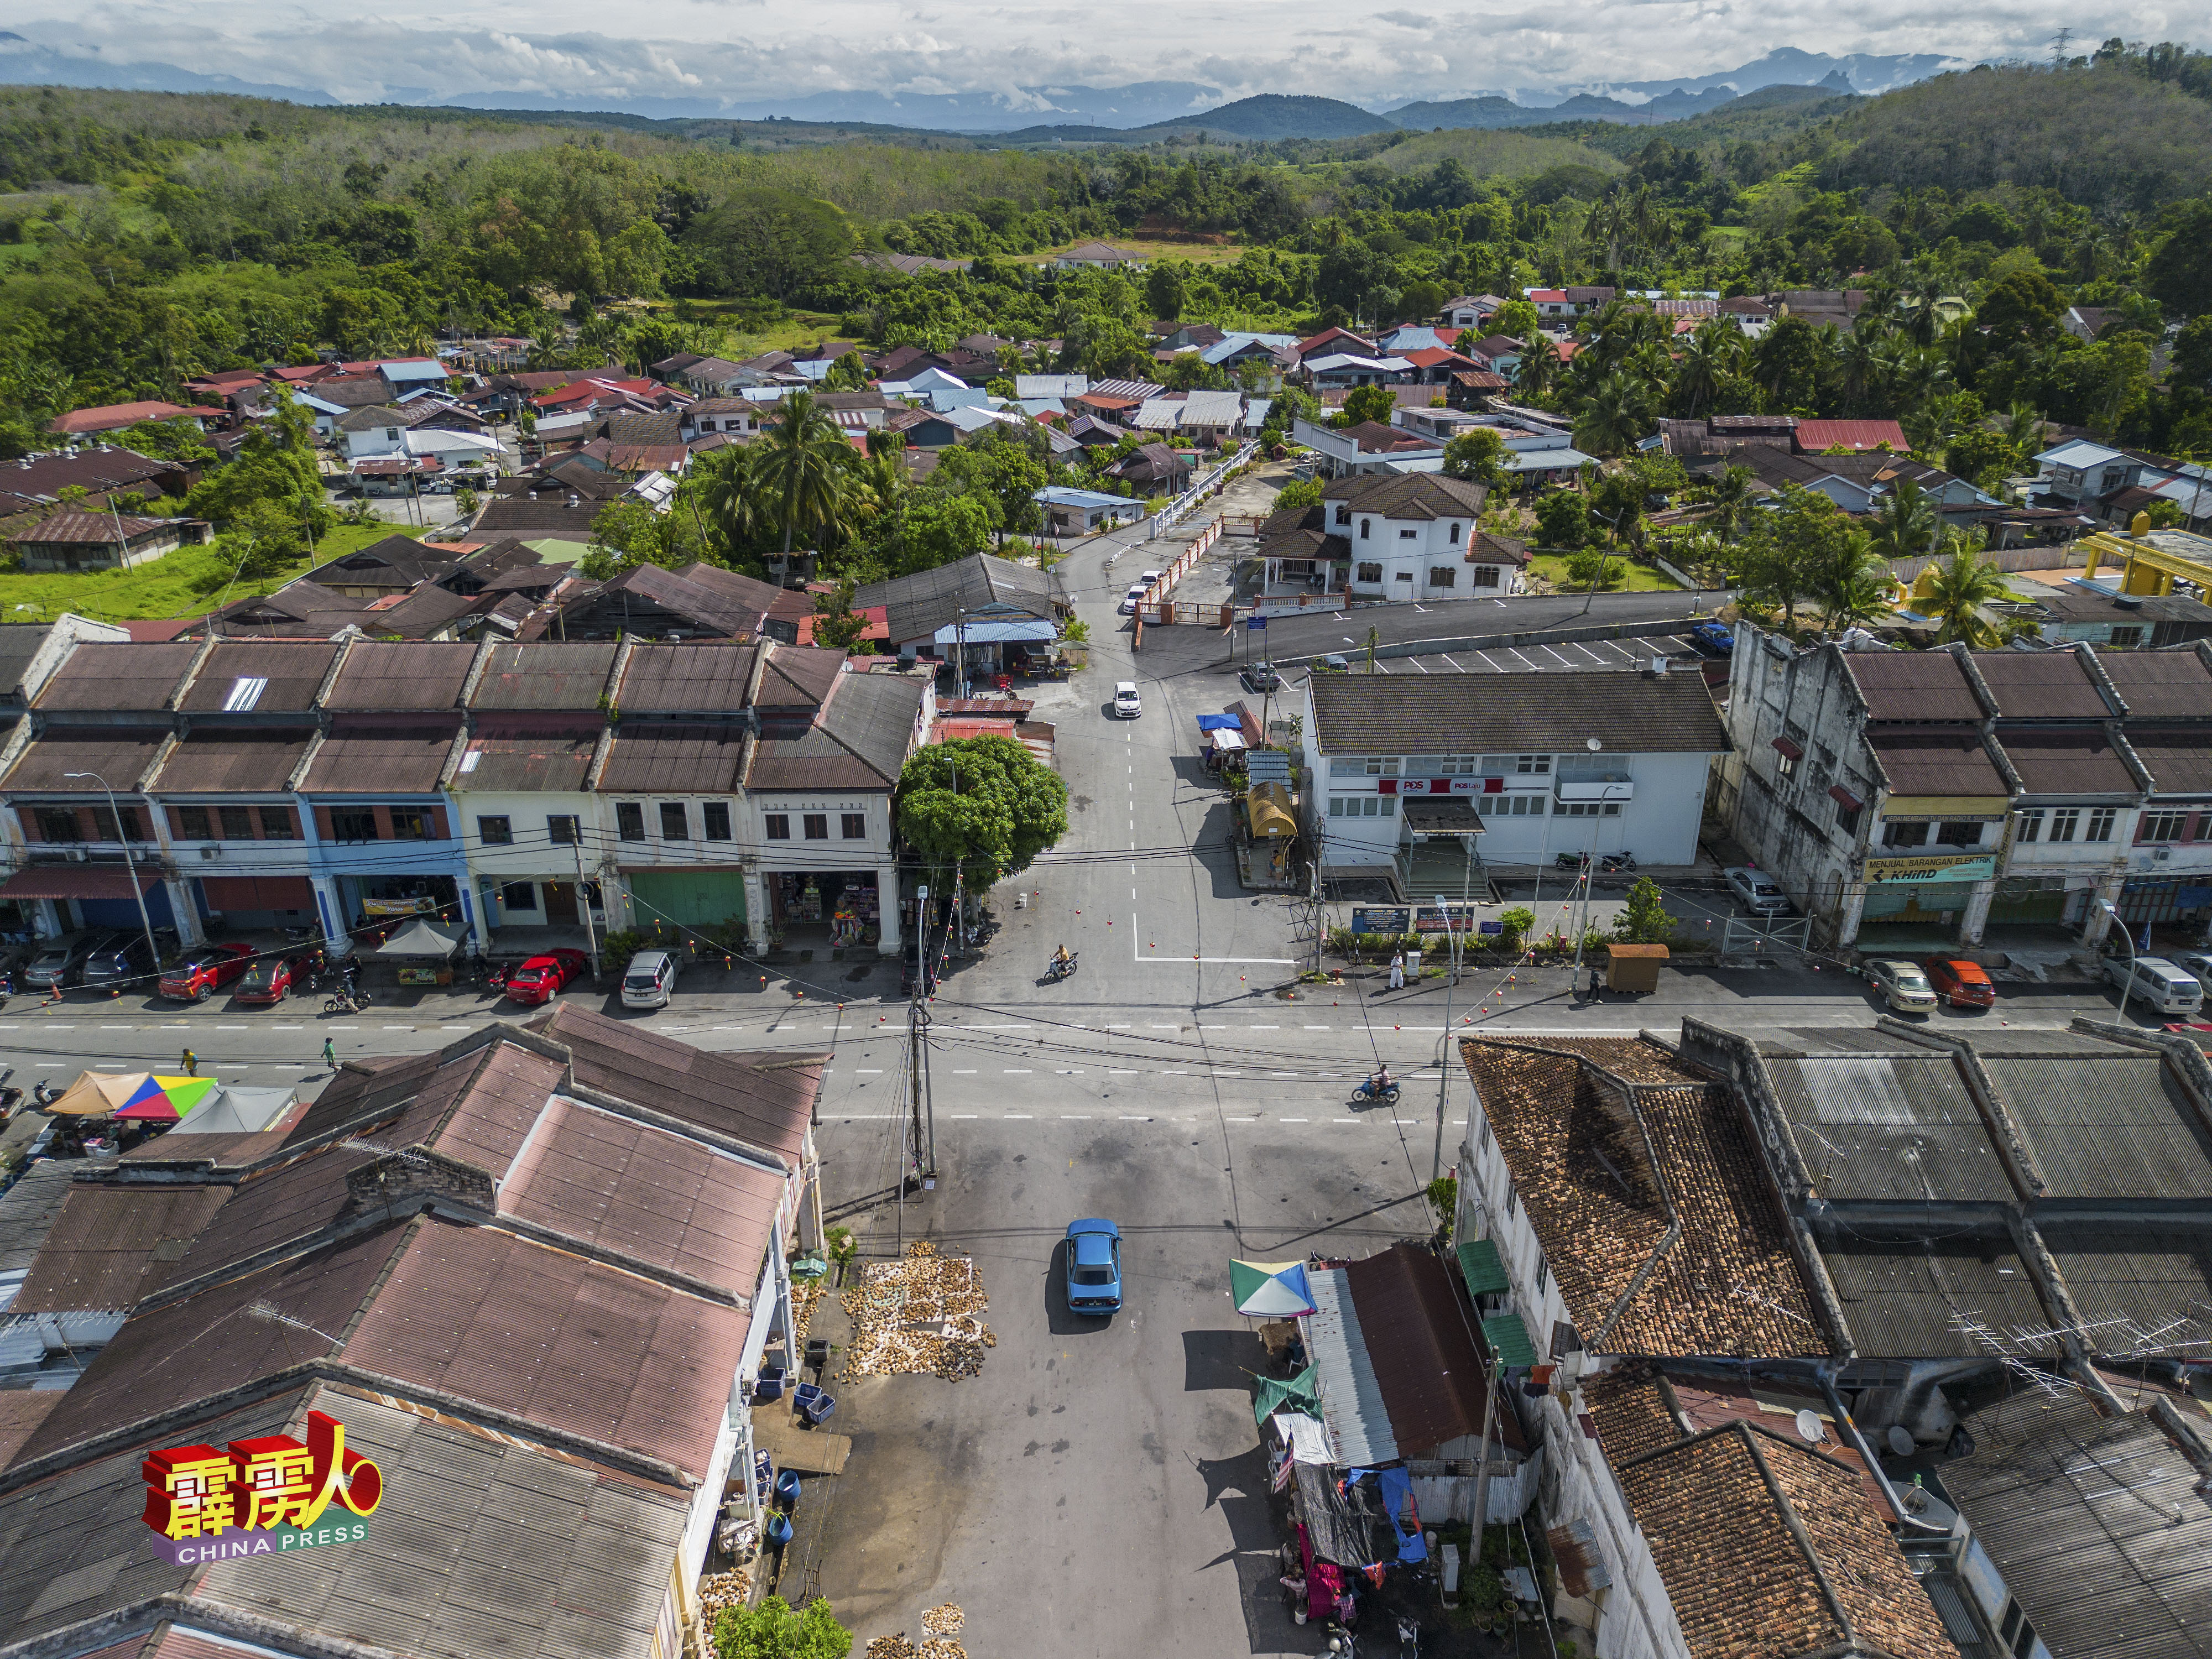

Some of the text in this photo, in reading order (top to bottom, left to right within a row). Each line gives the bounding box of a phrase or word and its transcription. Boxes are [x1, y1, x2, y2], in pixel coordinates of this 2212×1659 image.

[1404, 781, 1424, 790] POS
[1869, 856, 1992, 868] MENJUAL BARANGAN ELEKTRIK
